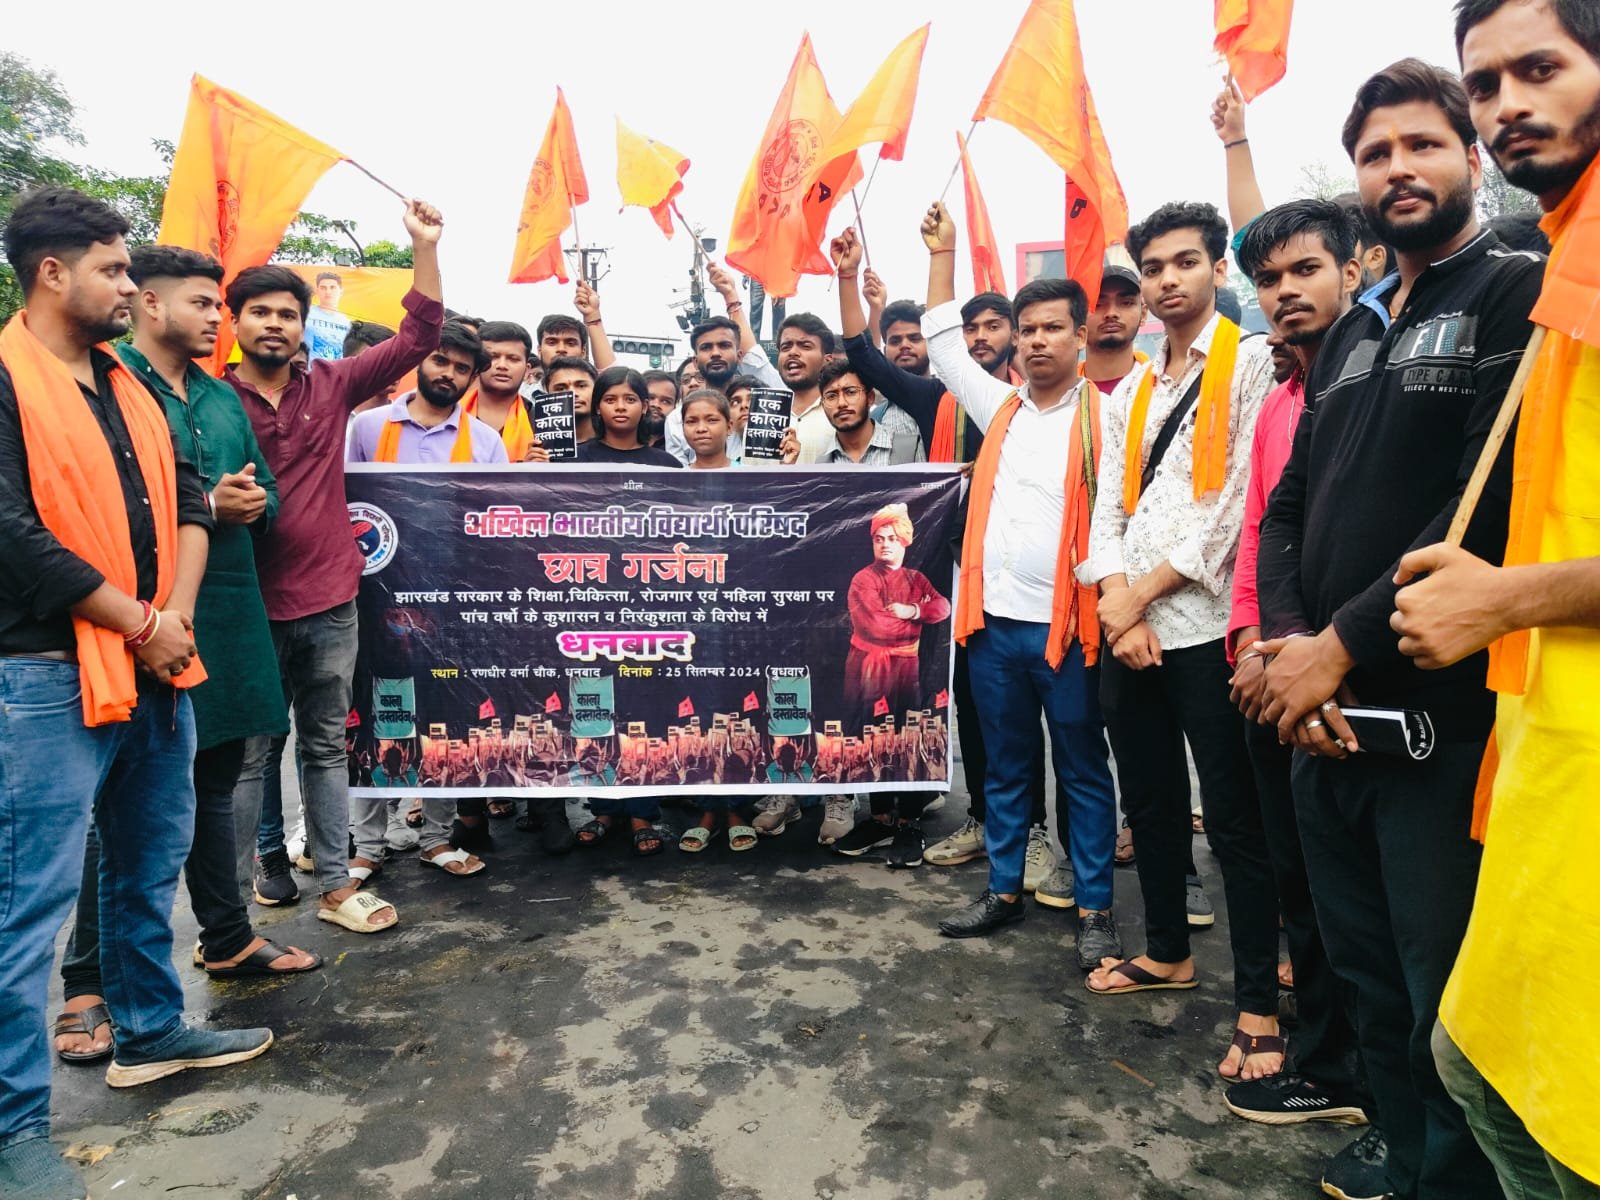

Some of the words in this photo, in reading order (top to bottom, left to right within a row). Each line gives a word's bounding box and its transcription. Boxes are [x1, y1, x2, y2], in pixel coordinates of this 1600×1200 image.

[542, 402, 563, 416] एक
[758, 398, 782, 413] एक
[535, 415, 572, 430] काला
[750, 412, 789, 427] काला
[464, 506, 549, 538] अखिल
[554, 506, 645, 538] भारतीय
[649, 504, 732, 538] विद्यार्थी
[732, 504, 809, 538] परिषद
[538, 553, 611, 584] छात्र
[622, 541, 729, 584] गर्जना
[394, 588, 450, 604] झारखंड
[454, 591, 503, 603] सरकार
[507, 587, 522, 602] के
[640, 587, 694, 603] रोजगार
[697, 588, 719, 604] एवं
[722, 587, 767, 603] महिला
[771, 590, 811, 606] सुरक्षा
[815, 590, 836, 602] पर
[460, 608, 488, 623] पांच
[523, 608, 538, 622] के
[542, 611, 600, 628] कुशासन
[604, 611, 615, 623] व
[619, 607, 688, 628] निरंकुशता
[691, 608, 706, 622] के
[710, 607, 752, 623] विरोध
[755, 607, 769, 622] में
[556, 630, 696, 662] धनबाद
[431, 668, 459, 678] स्थान
[471, 665, 506, 678] रणधीर
[509, 665, 530, 678] वर्मा
[565, 667, 601, 678] धनबाद
[618, 664, 653, 678] दिनांक
[666, 667, 681, 677] 25
[685, 664, 725, 677] सितम्बर
[729, 666, 760, 677] 2024
